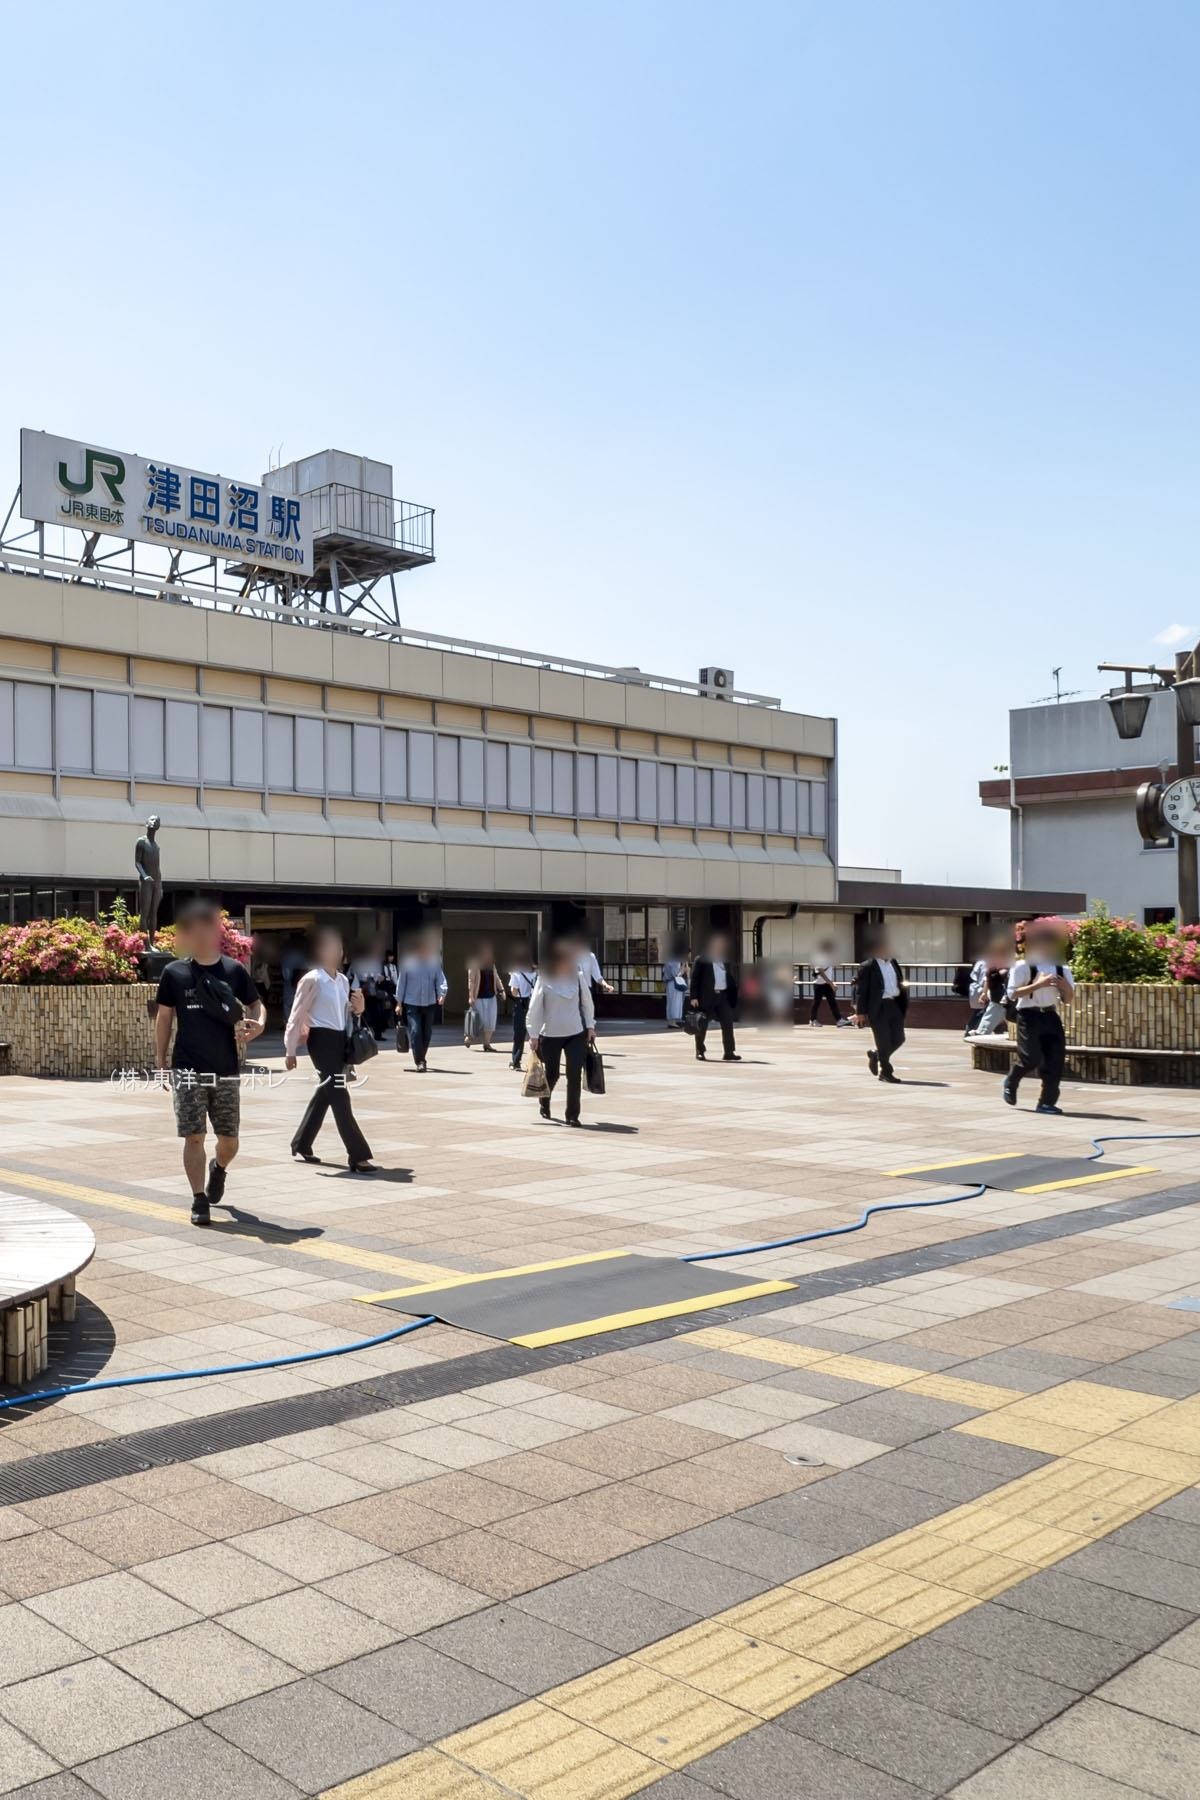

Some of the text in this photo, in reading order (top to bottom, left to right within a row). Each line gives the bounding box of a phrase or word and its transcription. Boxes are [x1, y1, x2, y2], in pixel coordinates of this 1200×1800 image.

[58, 447, 126, 504] JR
[61, 498, 125, 525] JR東日本
[147, 463, 302, 542] 津田沼駅
[142, 515, 305, 565] TSUDANUMA STATION
